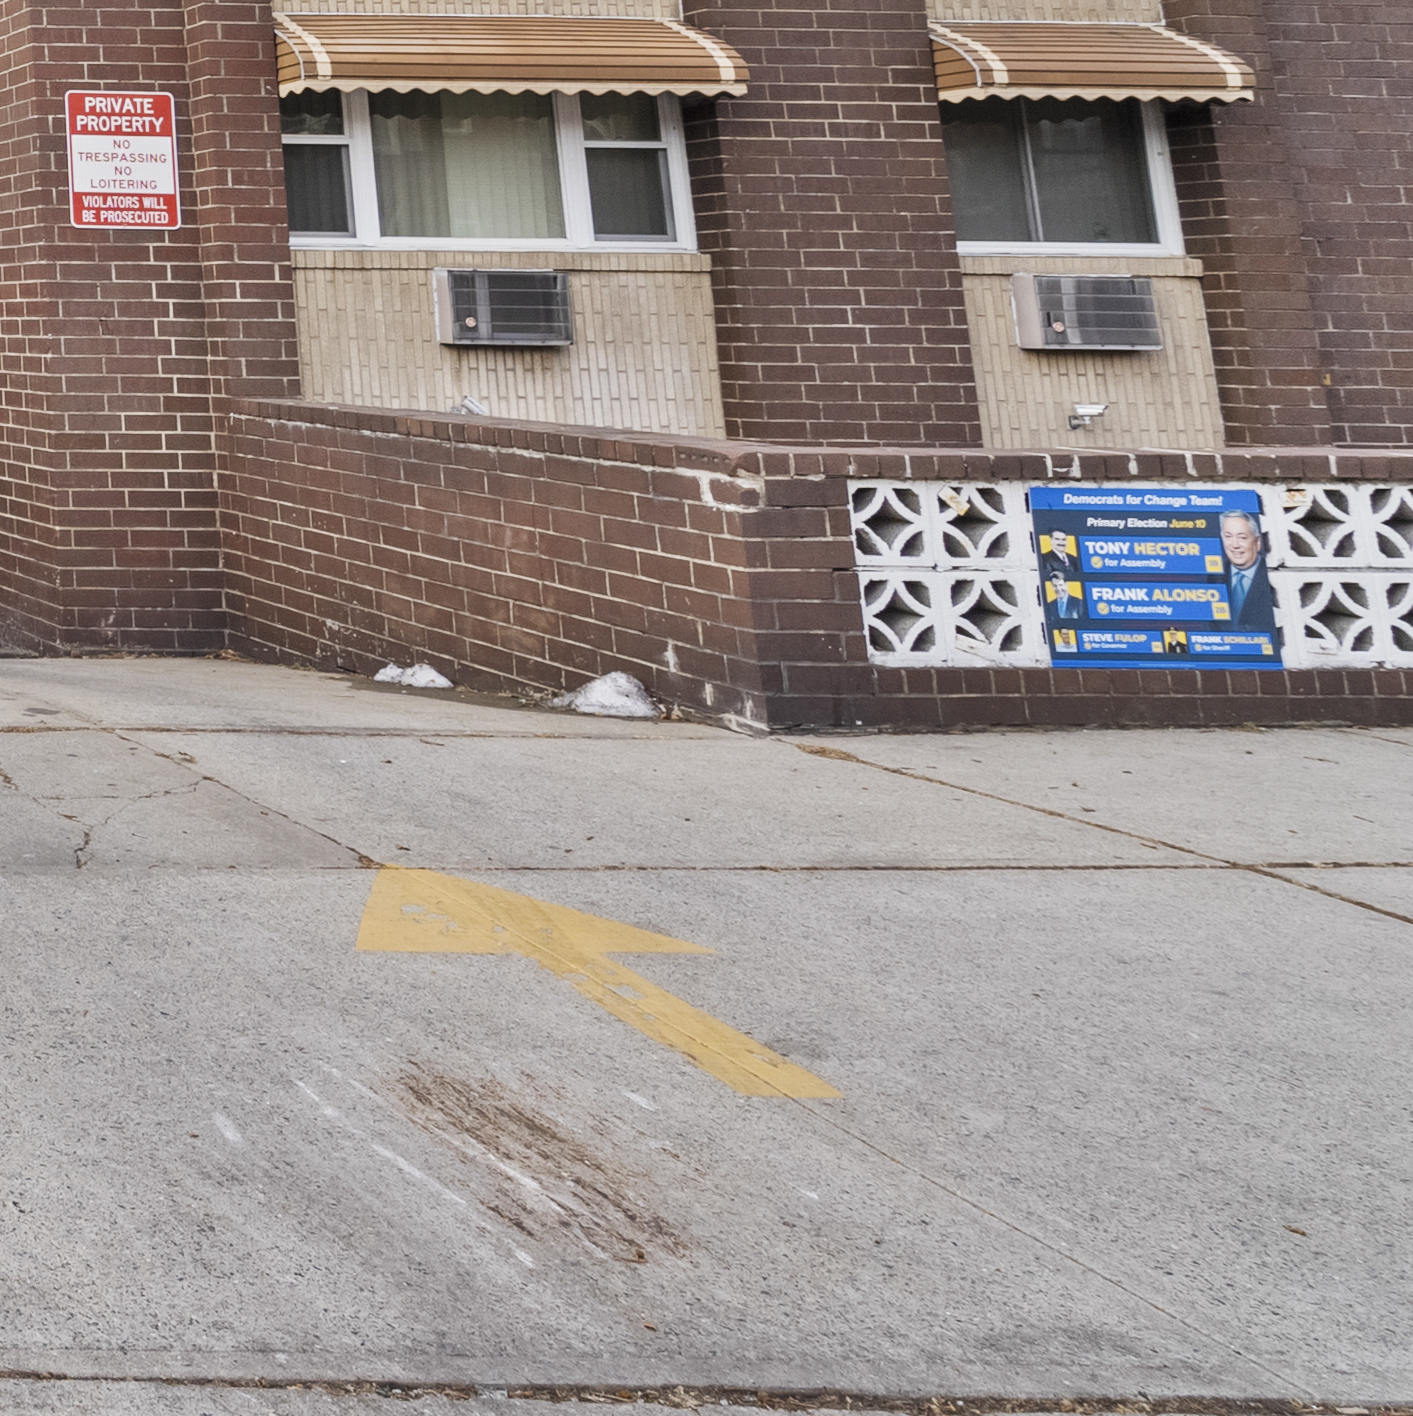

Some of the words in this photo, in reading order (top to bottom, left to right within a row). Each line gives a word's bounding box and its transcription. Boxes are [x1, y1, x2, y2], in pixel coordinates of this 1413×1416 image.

[84, 97, 154, 114] PRIVATE
[76, 115, 164, 133] PROPERTY
[113, 140, 131, 149] NO
[77, 152, 167, 163] TRESPASSING
[114, 166, 132, 176] NO
[90, 179, 158, 190] LOITERING
[82, 195, 140, 209] VIOLATORS
[142, 197, 168, 209] WILL
[82, 210, 97, 223] BE
[100, 211, 169, 224] PROSECUTED
[1063, 494, 1124, 505] Democrats
[1125, 494, 1143, 505] for
[1143, 495, 1188, 507] Change
[1188, 495, 1223, 506] Team!
[1086, 518, 1126, 530] Primary
[1127, 518, 1168, 529] Election
[1169, 519, 1195, 529] June
[1195, 519, 1207, 529] 10
[1085, 541, 1131, 555] TONY
[1134, 542, 1201, 556] HECTOR
[1104, 558, 1119, 567] for
[1119, 558, 1166, 569] Assembly
[1091, 587, 1150, 601] FRANK
[1152, 588, 1220, 602] ALONSO
[1110, 604, 1126, 613] for
[1126, 604, 1173, 616] Assembly
[1082, 633, 1113, 642] STEVE
[1114, 634, 1147, 642] FULOP
[1191, 635, 1223, 643] FRANK
